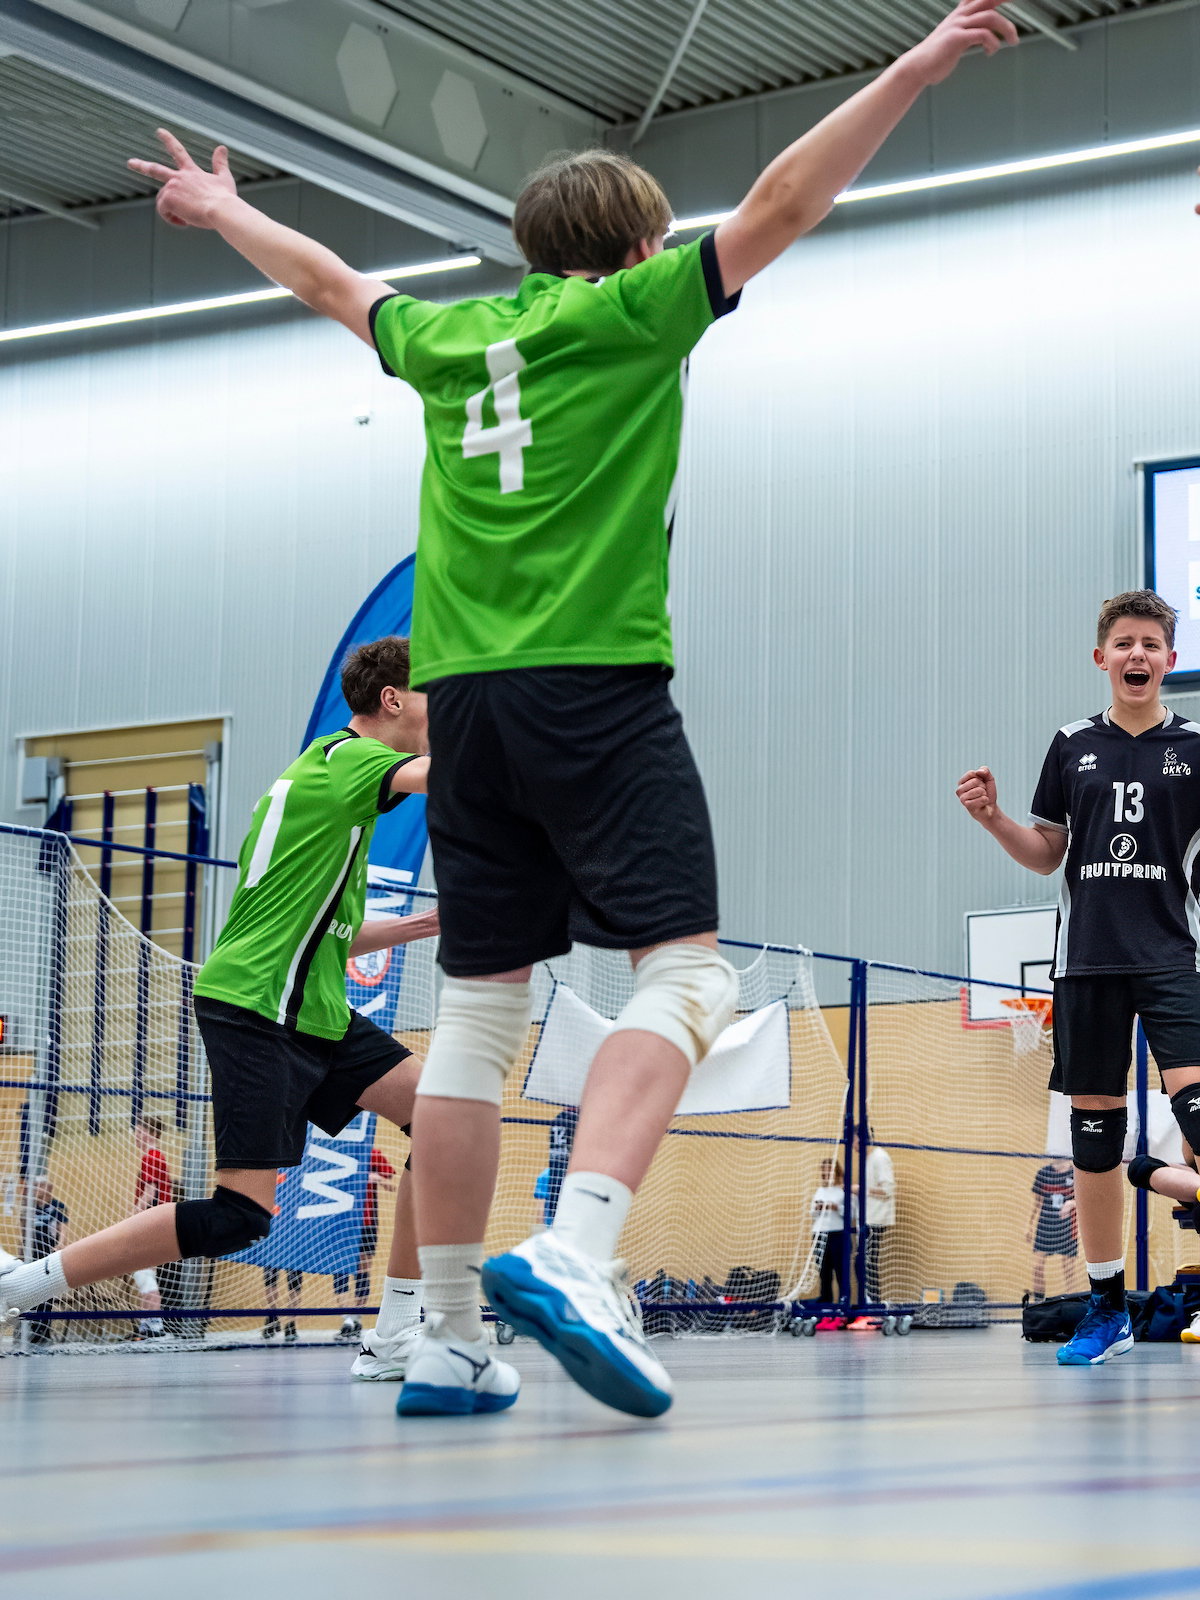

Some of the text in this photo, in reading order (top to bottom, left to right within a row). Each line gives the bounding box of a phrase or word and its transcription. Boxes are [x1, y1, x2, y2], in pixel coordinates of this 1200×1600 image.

[462, 338, 533, 495] 4
[1112, 782, 1144, 823] 13
[1080, 862, 1167, 881] FRUITPRINT
